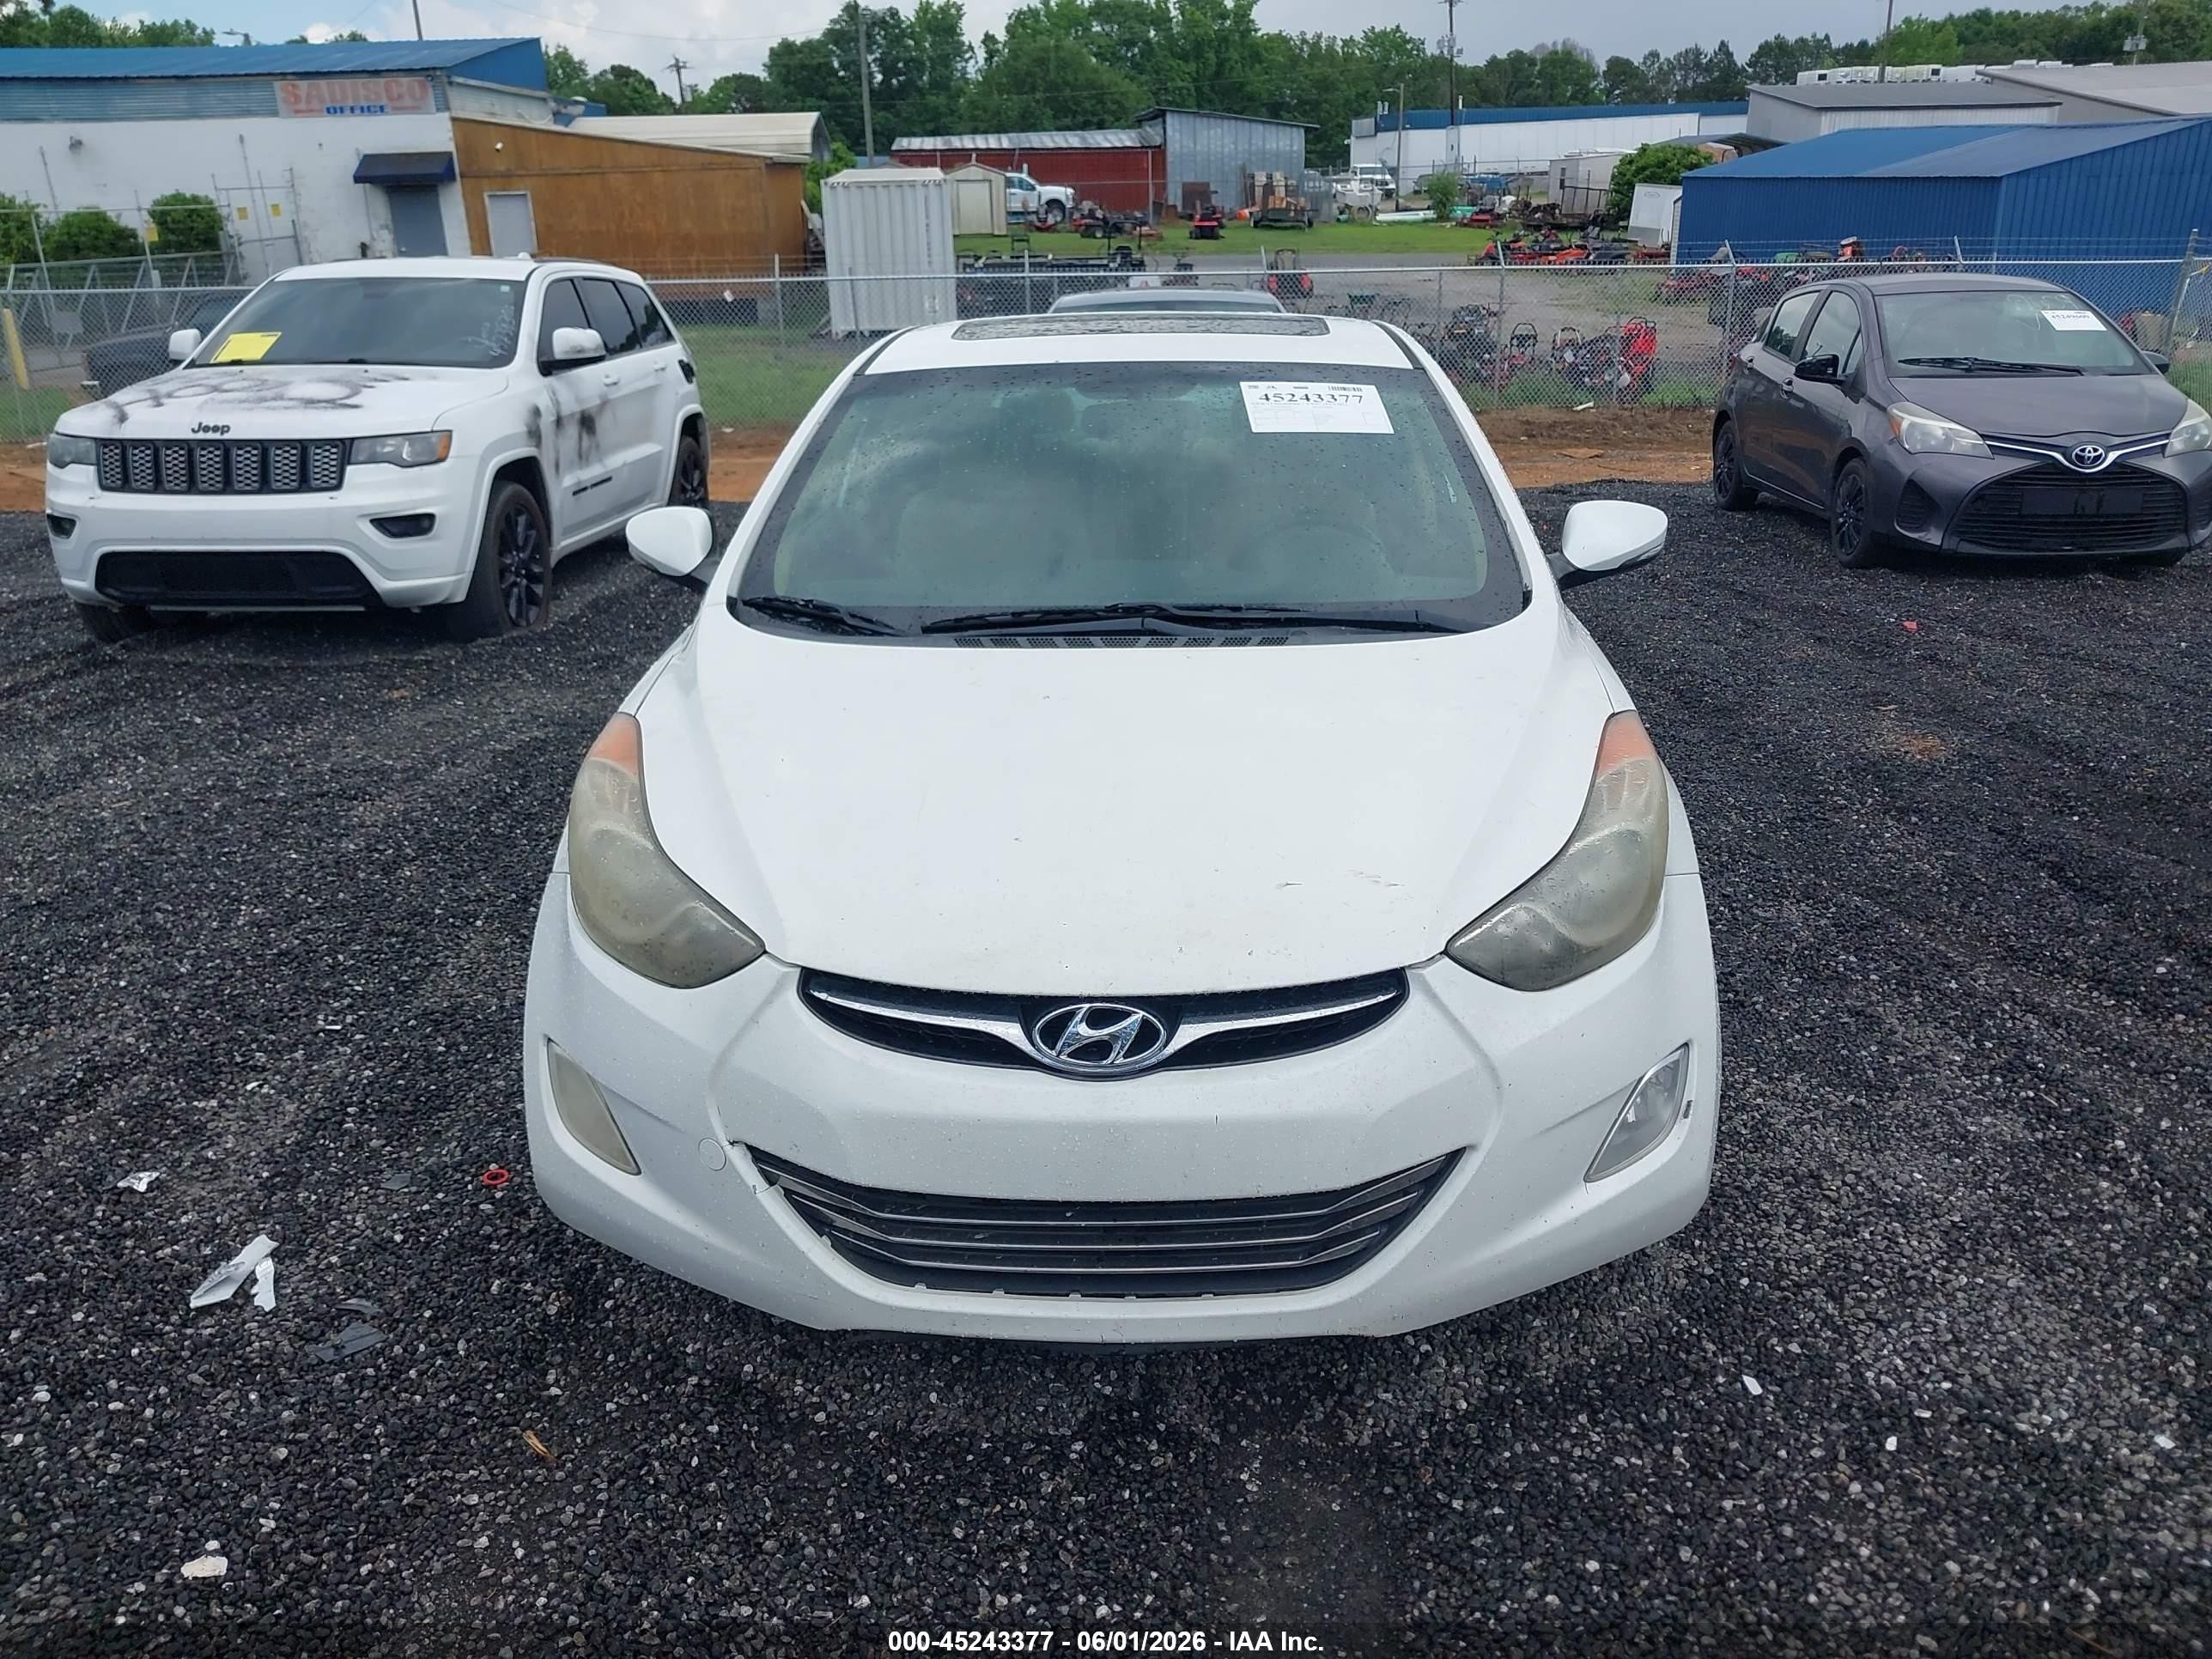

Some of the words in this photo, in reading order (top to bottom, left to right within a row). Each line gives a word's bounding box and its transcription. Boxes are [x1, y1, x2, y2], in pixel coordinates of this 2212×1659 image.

[281, 77, 428, 105] SADISCO
[325, 104, 386, 115] OFFICE
[1258, 392, 1364, 404] 45243377
[191, 422, 231, 436] Jeep
